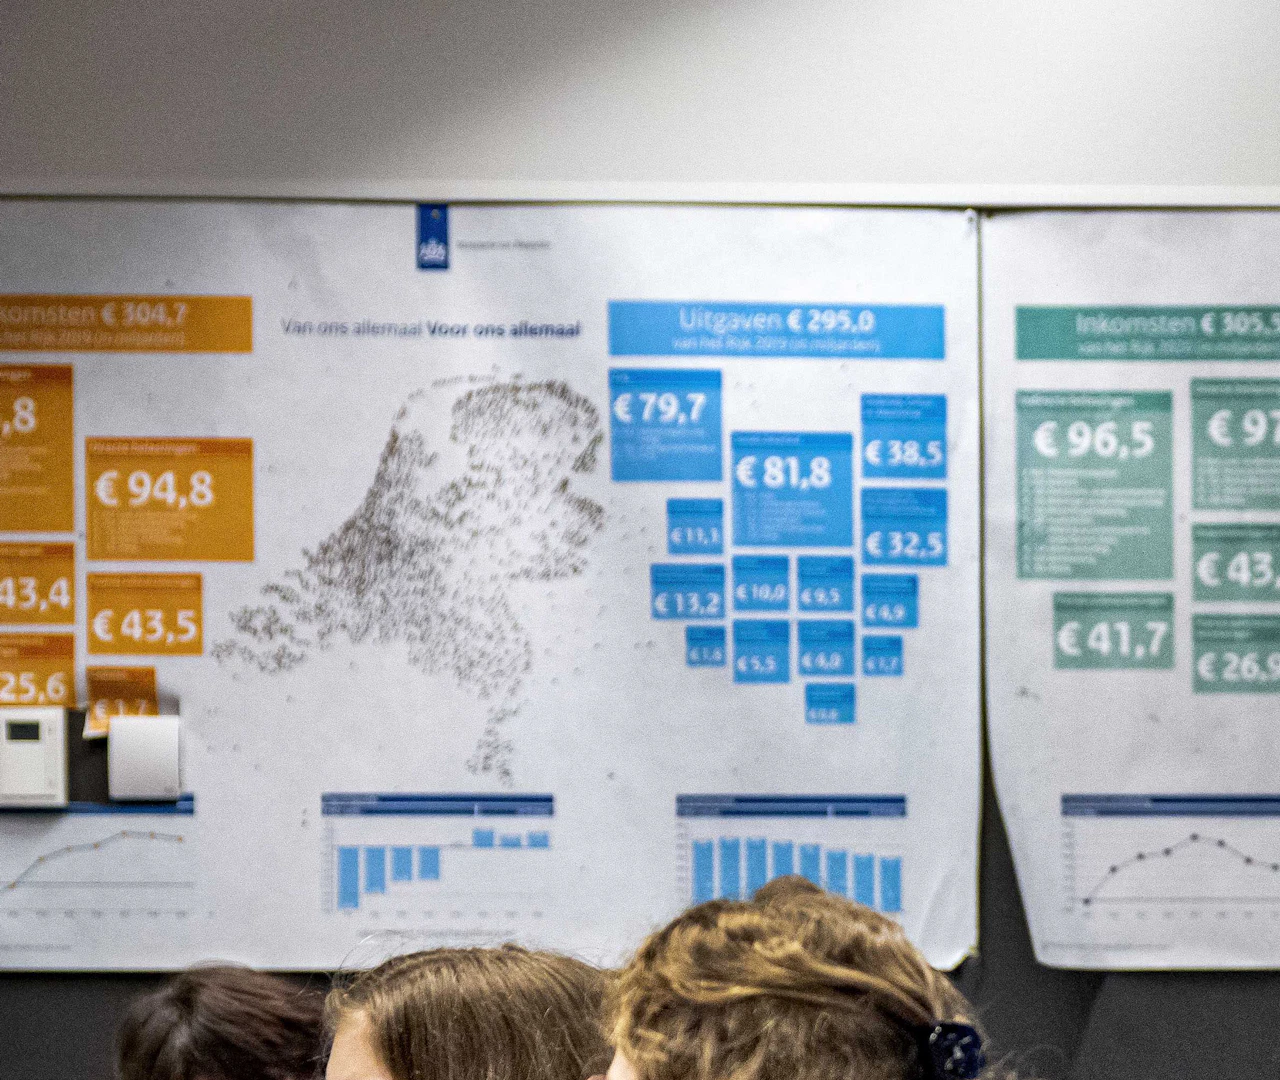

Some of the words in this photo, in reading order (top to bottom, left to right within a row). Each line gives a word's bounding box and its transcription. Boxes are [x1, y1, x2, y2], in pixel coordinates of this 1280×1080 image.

[282, 317, 313, 335] Van
[318, 321, 349, 336] ons
[353, 318, 422, 336] allemaal
[427, 321, 469, 337] Voor
[474, 324, 505, 338] ons
[510, 321, 581, 338] allemaal
[679, 307, 782, 333] Uitgaven
[807, 308, 875, 332] 295,0
[1076, 312, 1194, 334] Inkomsten
[613, 392, 631, 424] €
[640, 392, 706, 426] 79,7
[1033, 421, 1058, 456] €
[1068, 421, 1154, 459] 96,5
[1208, 410, 1232, 447] €
[865, 440, 881, 465] €
[889, 439, 943, 468] 38,5
[736, 456, 756, 486] €
[763, 455, 832, 489] 81,8
[95, 471, 118, 507] €
[128, 471, 215, 509] 94,8
[865, 532, 882, 558] €
[1197, 553, 1219, 587] €
[655, 592, 668, 613] €
[92, 609, 114, 642] €
[120, 609, 197, 645] 43,5
[1057, 621, 1078, 656] €
[1087, 620, 1169, 658] 41,7
[1197, 653, 1217, 682] €
[0, 671, 66, 703] 25,6
